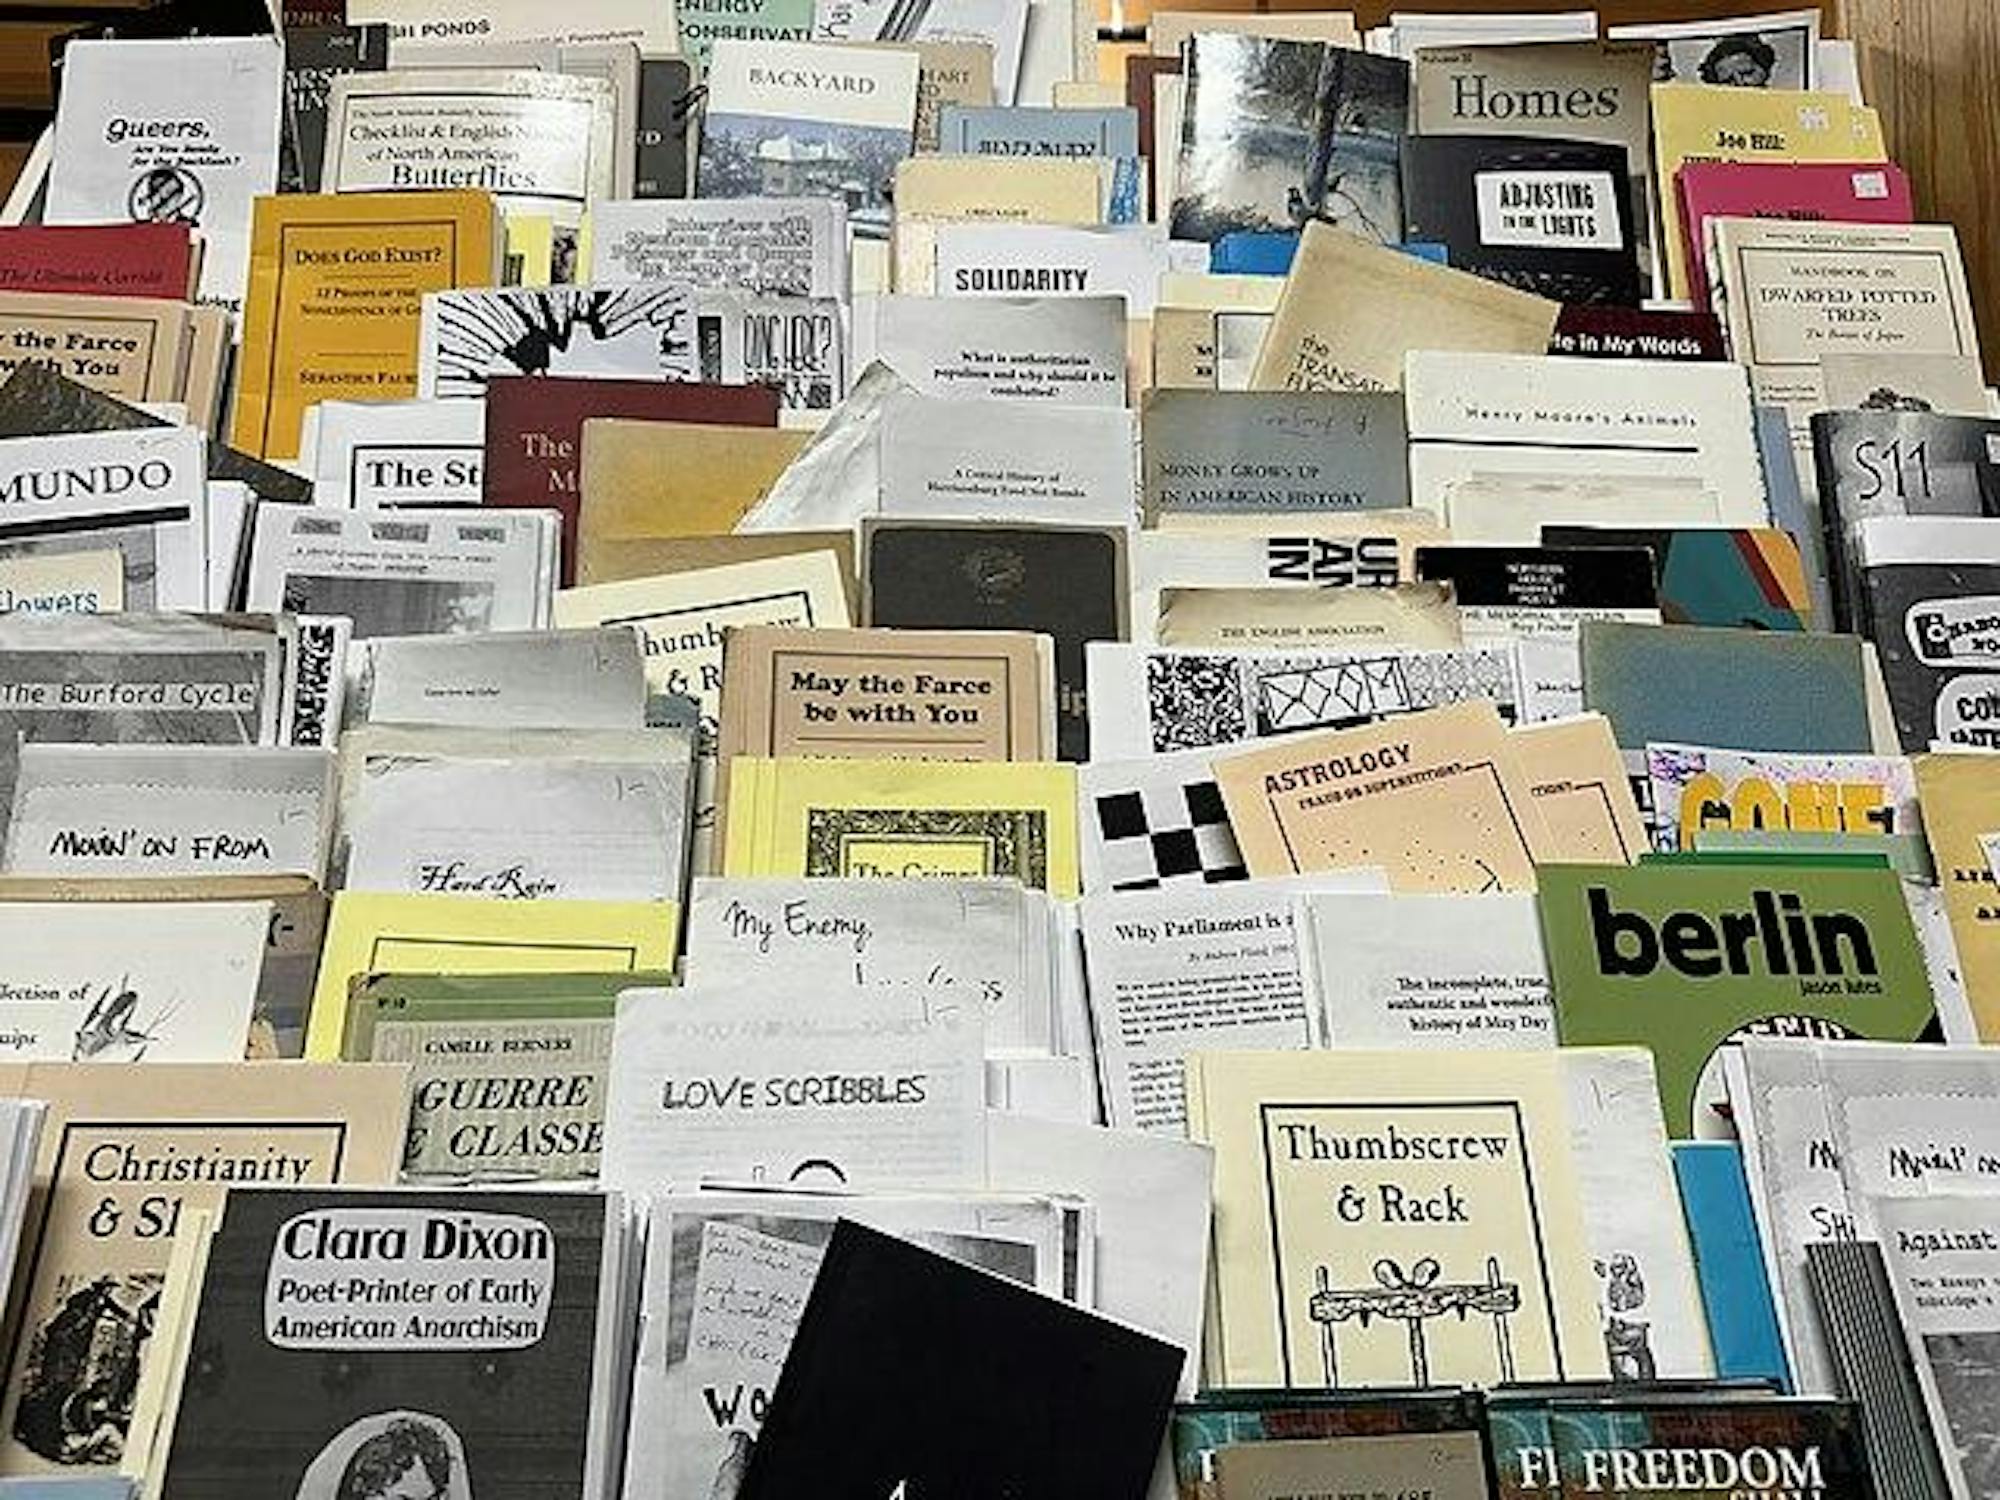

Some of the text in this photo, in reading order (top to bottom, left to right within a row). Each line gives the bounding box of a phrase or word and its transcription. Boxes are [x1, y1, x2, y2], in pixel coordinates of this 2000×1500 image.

[422, 19, 491, 38] PONDS
[749, 69, 875, 95] BACKYARD
[1451, 74, 1620, 120] Homes
[106, 118, 210, 143] Queers,
[350, 123, 513, 143] Checklist & English
[1716, 130, 1747, 149] Joe
[386, 146, 434, 161] North
[437, 147, 519, 163] American
[393, 163, 537, 187] Butterflies
[1500, 183, 1595, 210] ADJUSTING
[1542, 215, 1596, 238] LIGHTS
[296, 247, 441, 264] DOES GOD EXIST?
[955, 268, 1088, 292] SOLIDARITY
[1789, 266, 1897, 278] HANDBOOK ON
[1760, 287, 1937, 304] DWARFED POTTED
[1821, 308, 1882, 322] TREES
[13, 331, 138, 352] the Farce
[1578, 335, 1703, 356] in My Words
[73, 359, 120, 375] You
[962, 351, 993, 363] What
[997, 353, 1006, 363] is
[994, 368, 1016, 379] and
[1019, 369, 1043, 383] why
[1047, 369, 1088, 381] should
[1103, 371, 1116, 381] be
[1466, 408, 1698, 428] Henry Moore's Animals
[520, 433, 575, 457] The
[0, 460, 172, 503] MUNDO
[366, 461, 434, 487] The
[1160, 464, 1321, 479] MONEY GROWS UP
[1160, 490, 1367, 505] IN AMERICAN HISTORY
[790, 670, 992, 695] May the Farce
[1, 682, 253, 708] The Burford Cycle
[803, 702, 979, 723] be with You
[1264, 743, 1412, 795] ASTROLOGY
[143, 834, 178, 858] ON
[190, 834, 271, 860] FROM
[420, 862, 557, 895] Hard Rain
[723, 899, 874, 952] My Enemy,
[1115, 921, 1158, 943] Why
[1163, 914, 1263, 938] Parliament
[1265, 912, 1282, 928] is
[1587, 886, 1880, 978] berlin
[68, 981, 92, 1001] of
[1397, 976, 1424, 992] The
[1427, 974, 1513, 994] incomplete,
[1800, 980, 1882, 997] jason lutes
[1387, 996, 1456, 1011] authentic
[1459, 994, 1487, 1010] and
[1409, 1014, 1549, 1034] history of May Day
[425, 1039, 495, 1054] CAMILLE
[417, 1074, 595, 1111] GUERRE
[662, 1073, 928, 1109] LOVE SCRIBBLES
[449, 1120, 604, 1157] CLASSE
[1278, 1123, 1510, 1161] Thumbscrew
[85, 1141, 312, 1184] Christianity
[1337, 1184, 1471, 1223] & Rack
[89, 1197, 124, 1238] &
[284, 1218, 548, 1260] Clara Dixon
[1897, 1228, 2000, 1259] Against
[277, 1276, 545, 1308] Poet-Printer of Early
[272, 1315, 539, 1340] American Anarchism
[1583, 1445, 1828, 1492] FREEDOM
